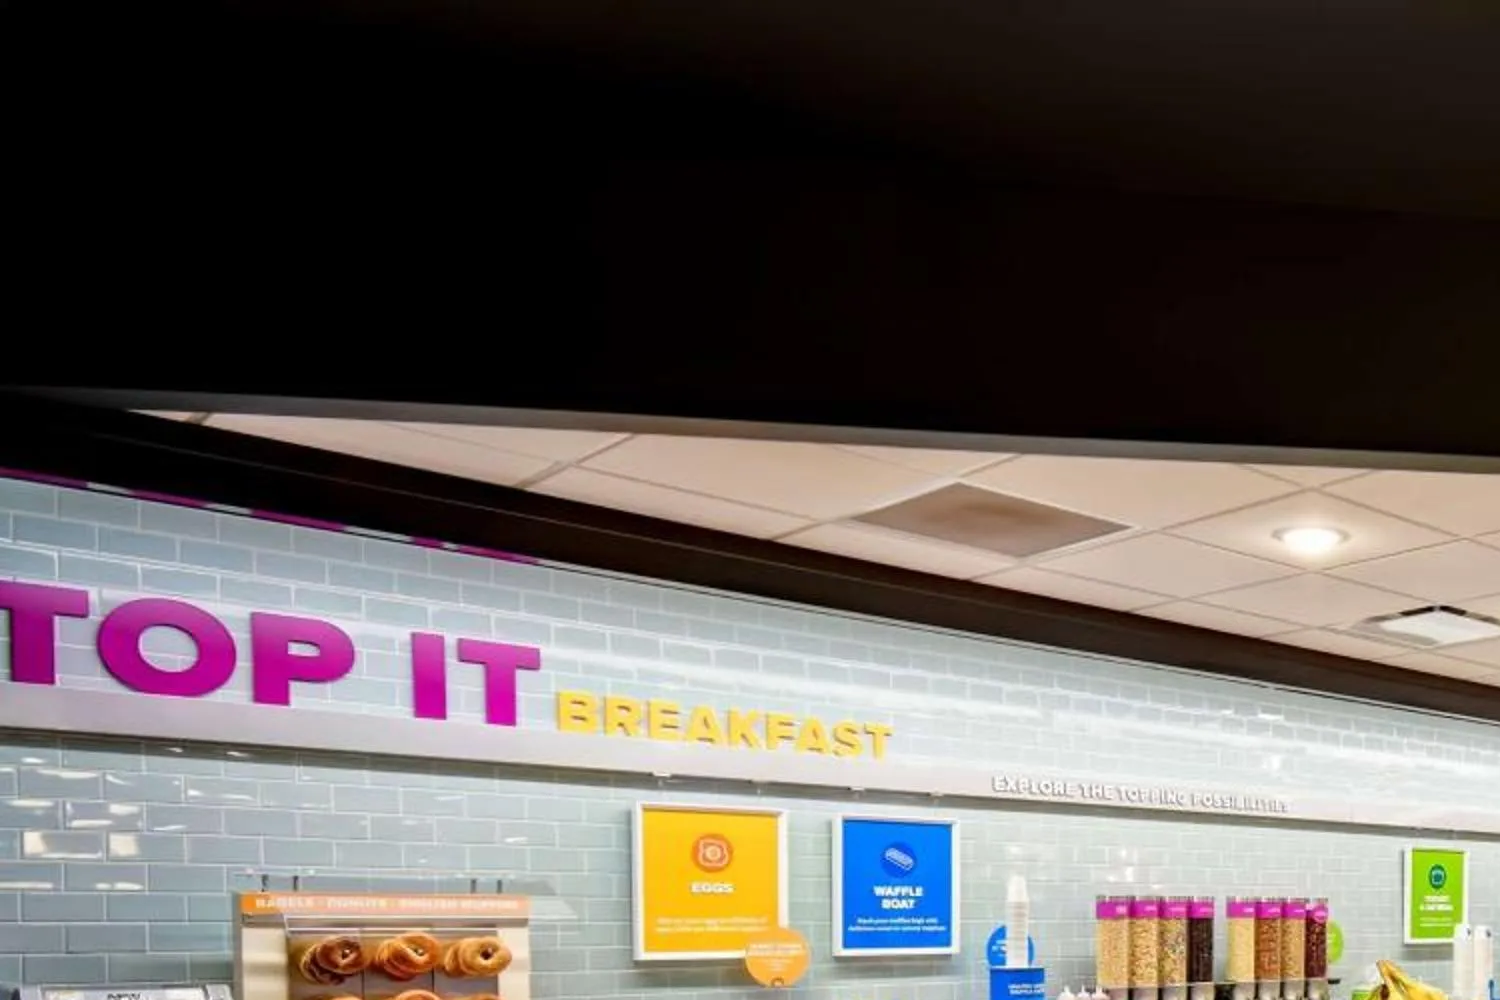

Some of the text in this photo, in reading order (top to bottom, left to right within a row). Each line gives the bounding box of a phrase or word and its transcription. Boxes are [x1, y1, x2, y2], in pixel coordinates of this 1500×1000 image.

[0, 579, 541, 726] TOP IT
[557, 690, 893, 760] BREAKFAST
[992, 775, 1077, 797] EXPLORE
[1080, 784, 1114, 801] THE
[691, 881, 736, 894] EGGS
[873, 885, 923, 897] WAFFLE
[881, 898, 917, 909] BOAT
